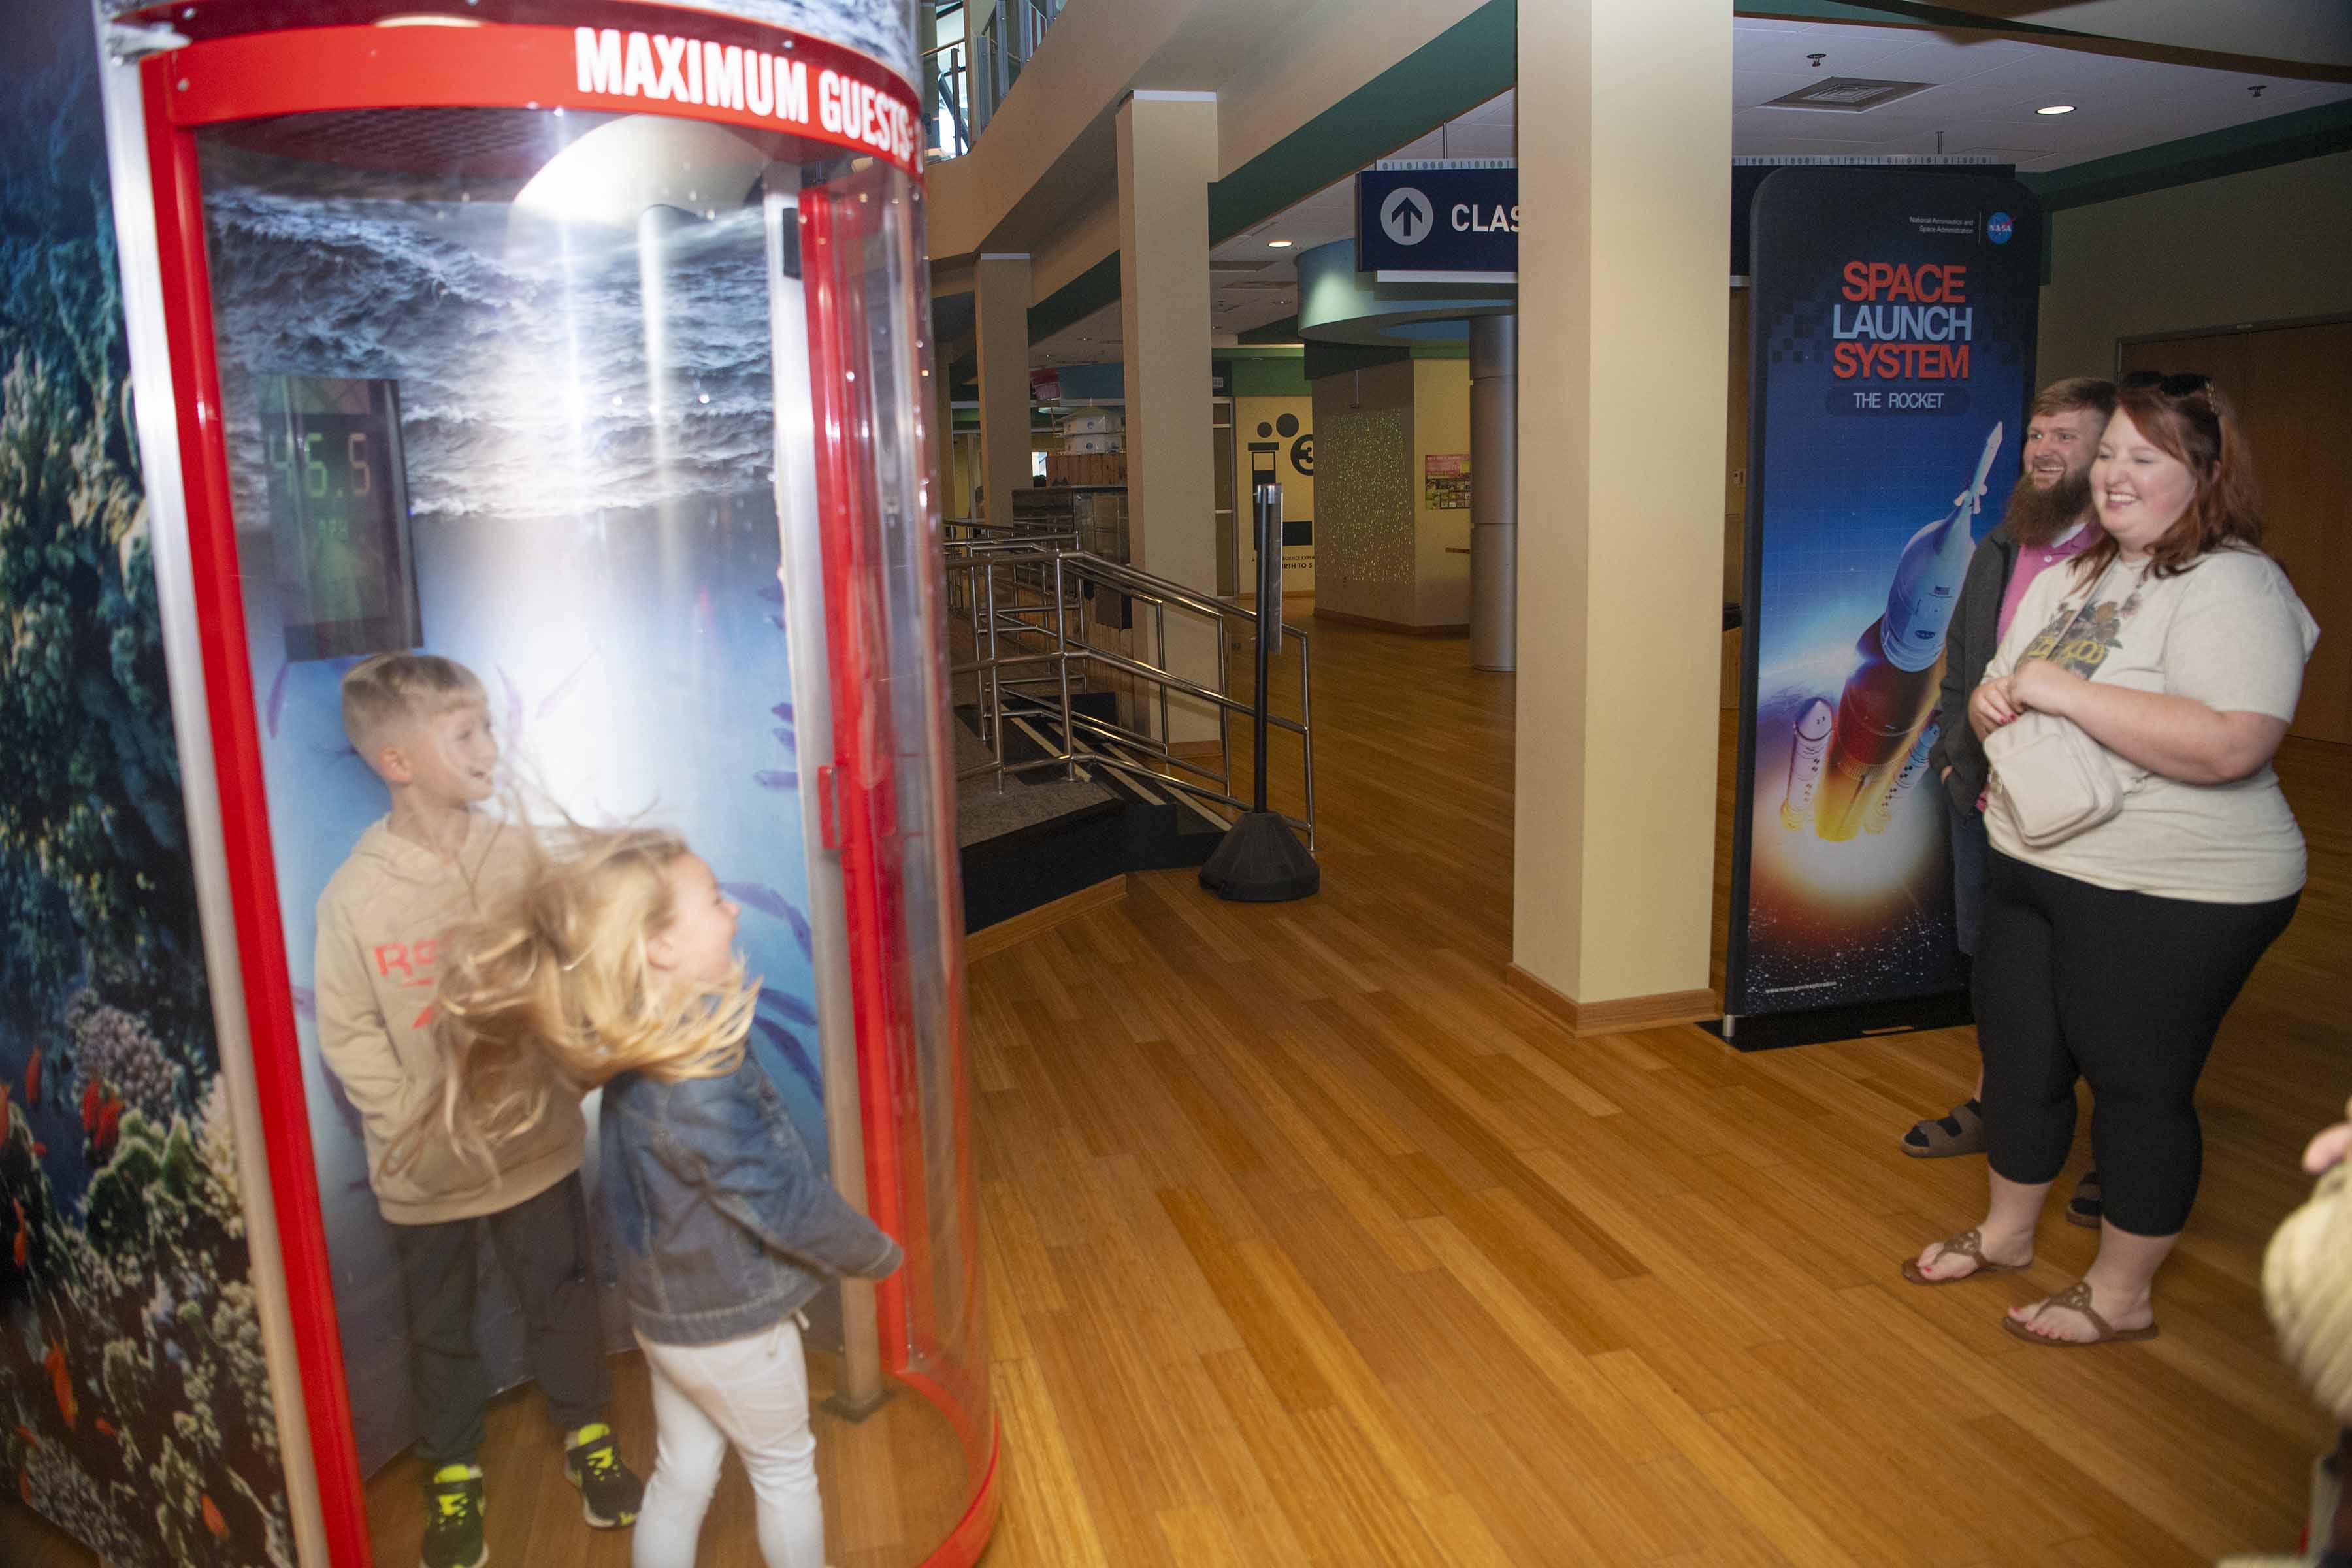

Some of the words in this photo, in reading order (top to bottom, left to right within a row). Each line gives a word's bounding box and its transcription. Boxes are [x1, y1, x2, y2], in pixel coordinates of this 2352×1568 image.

[575, 26, 809, 125] MAXIMUM
[1842, 261, 1967, 303] SPACE
[1833, 304, 1972, 341] LAUNCH
[1833, 342, 1970, 379] SYSTEM
[1853, 392, 1881, 408] THE
[1889, 392, 1945, 409] ROCKET
